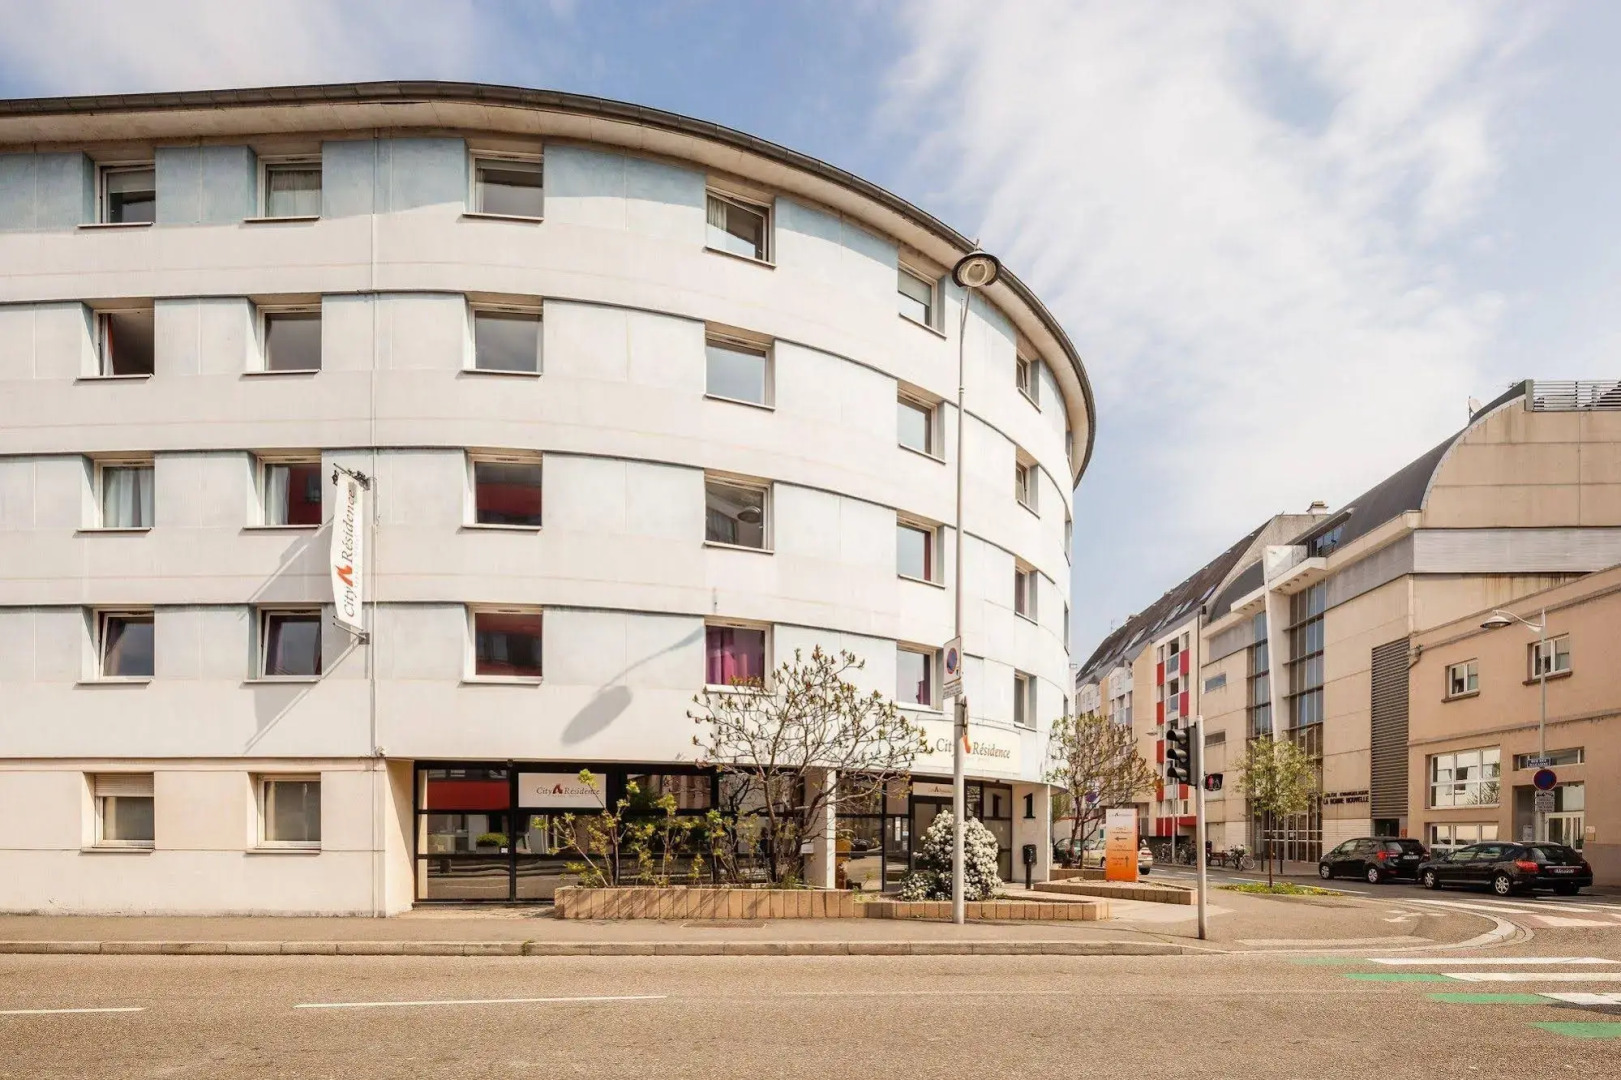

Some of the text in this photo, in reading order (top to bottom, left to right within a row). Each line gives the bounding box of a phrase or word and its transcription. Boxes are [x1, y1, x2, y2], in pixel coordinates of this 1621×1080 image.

[342, 489, 357, 618] City Résidence
[972, 742, 1011, 759] Résidence
[536, 787, 552, 796] City
[1023, 792, 1036, 819] 1
